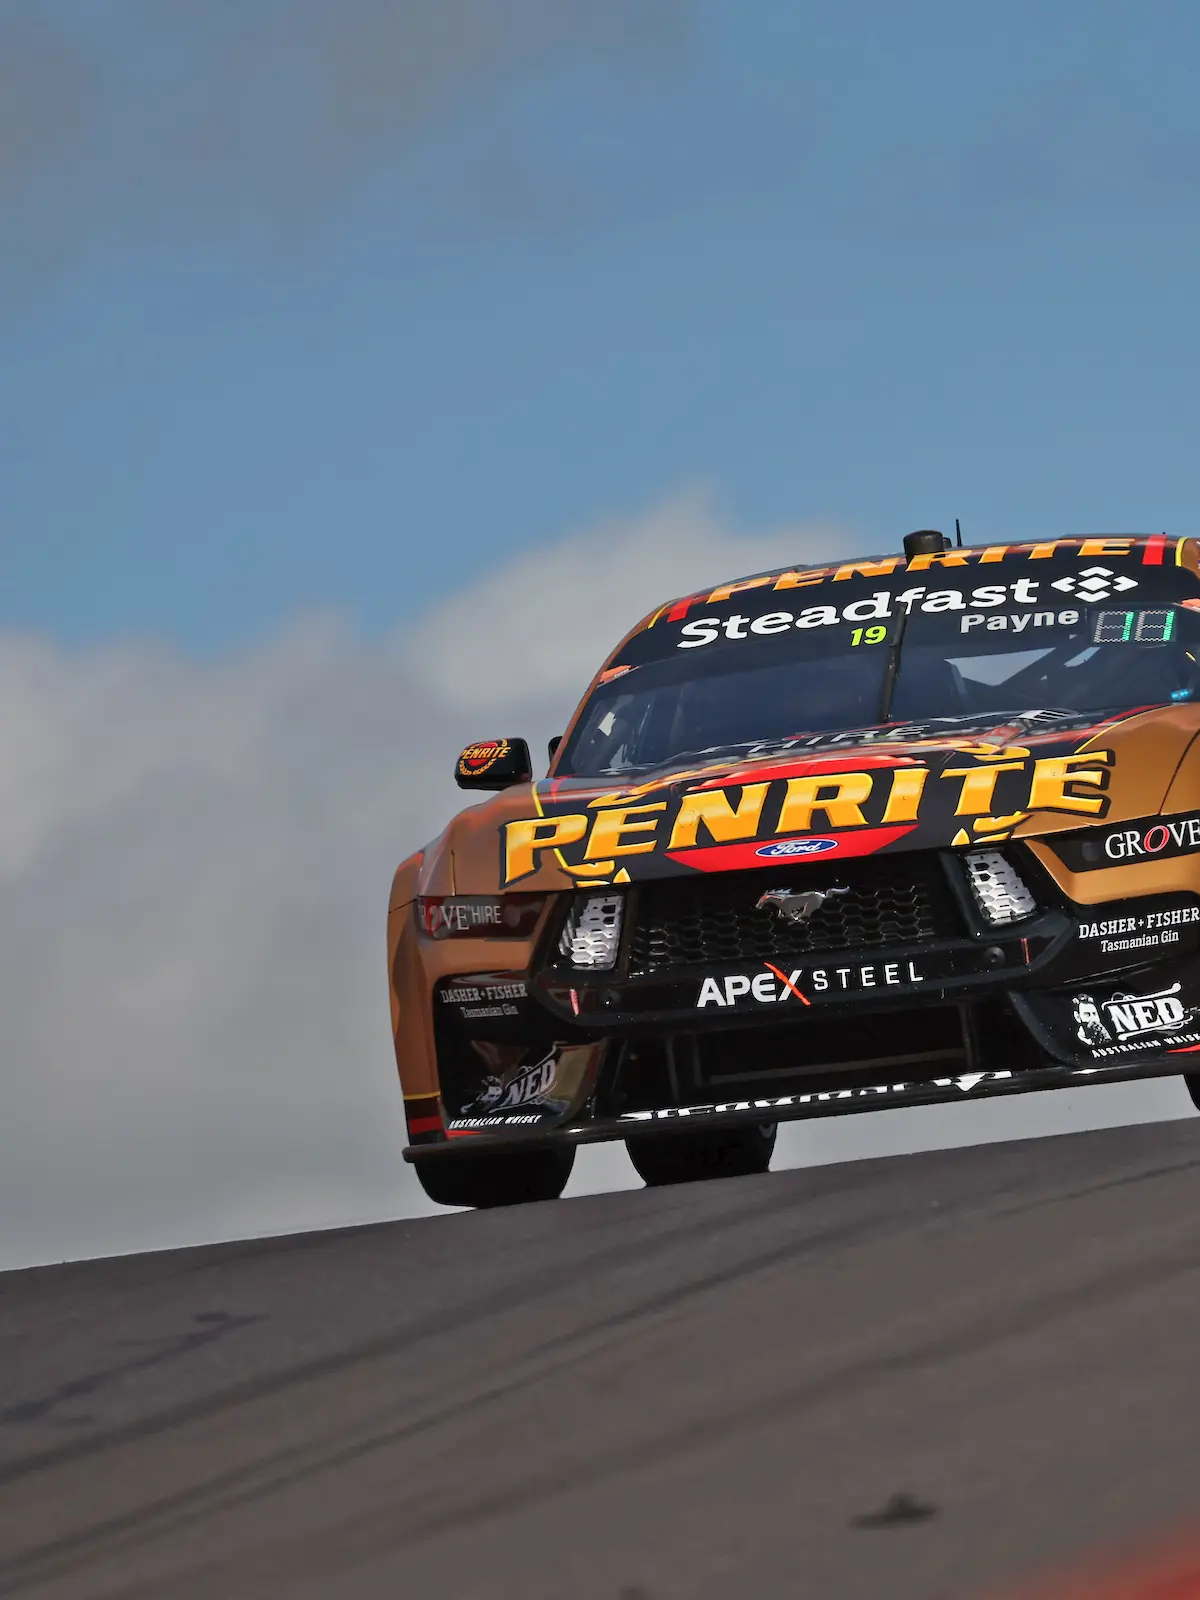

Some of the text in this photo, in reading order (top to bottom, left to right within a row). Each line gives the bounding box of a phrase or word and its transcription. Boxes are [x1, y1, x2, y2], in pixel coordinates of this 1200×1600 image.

[676, 577, 1039, 648] Steadfast
[961, 606, 1079, 633] Payne
[851, 625, 887, 647] 19
[504, 749, 1109, 884] PENRITE
[769, 840, 823, 856] Ford
[471, 905, 502, 924] HIRE
[1079, 916, 1137, 939] DASHER
[1147, 907, 1200, 929] FISHER
[1101, 930, 1179, 953] Tasmanian Gin
[441, 988, 481, 1003] DASHER
[486, 984, 528, 1001] FISHER
[697, 962, 924, 1008] APEX STEEL
[460, 1003, 519, 1018] Tasmanian Gin
[1108, 997, 1185, 1034] NED
[1092, 1040, 1161, 1058] AUSTRALIAN
[499, 1059, 556, 1107] NED
[448, 1117, 504, 1129] AUSTRALIAN
